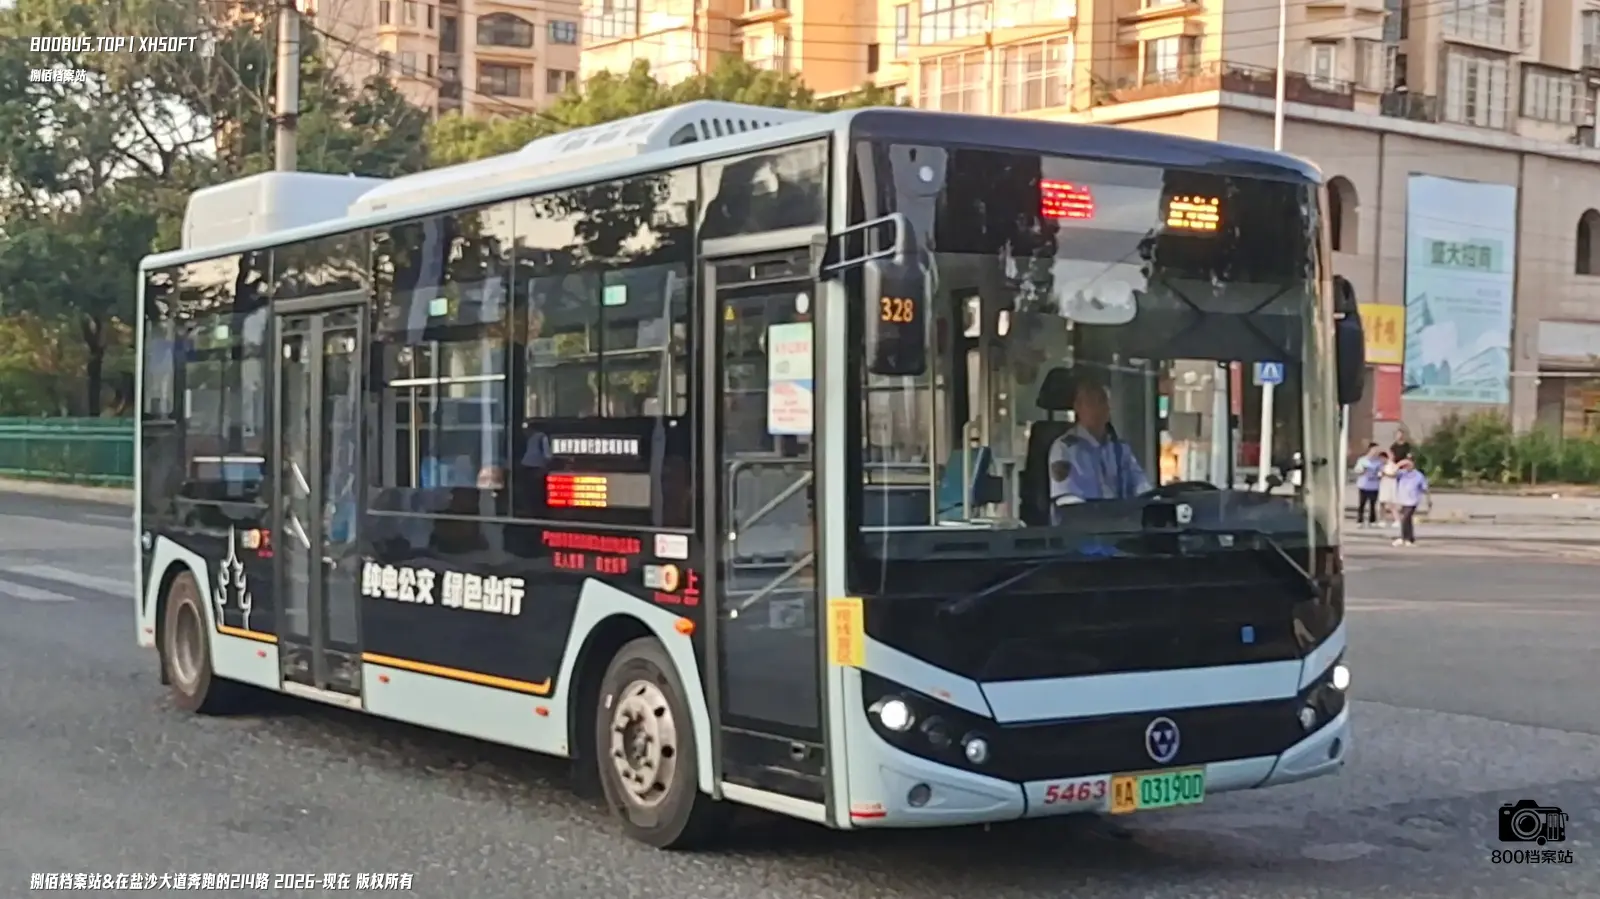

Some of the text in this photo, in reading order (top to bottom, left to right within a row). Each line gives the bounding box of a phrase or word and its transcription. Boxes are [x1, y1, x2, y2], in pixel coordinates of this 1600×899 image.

[880, 296, 914, 322] 328
[362, 562, 525, 616] 纯电公交 绿色出行
[1044, 780, 1107, 805] 5463
